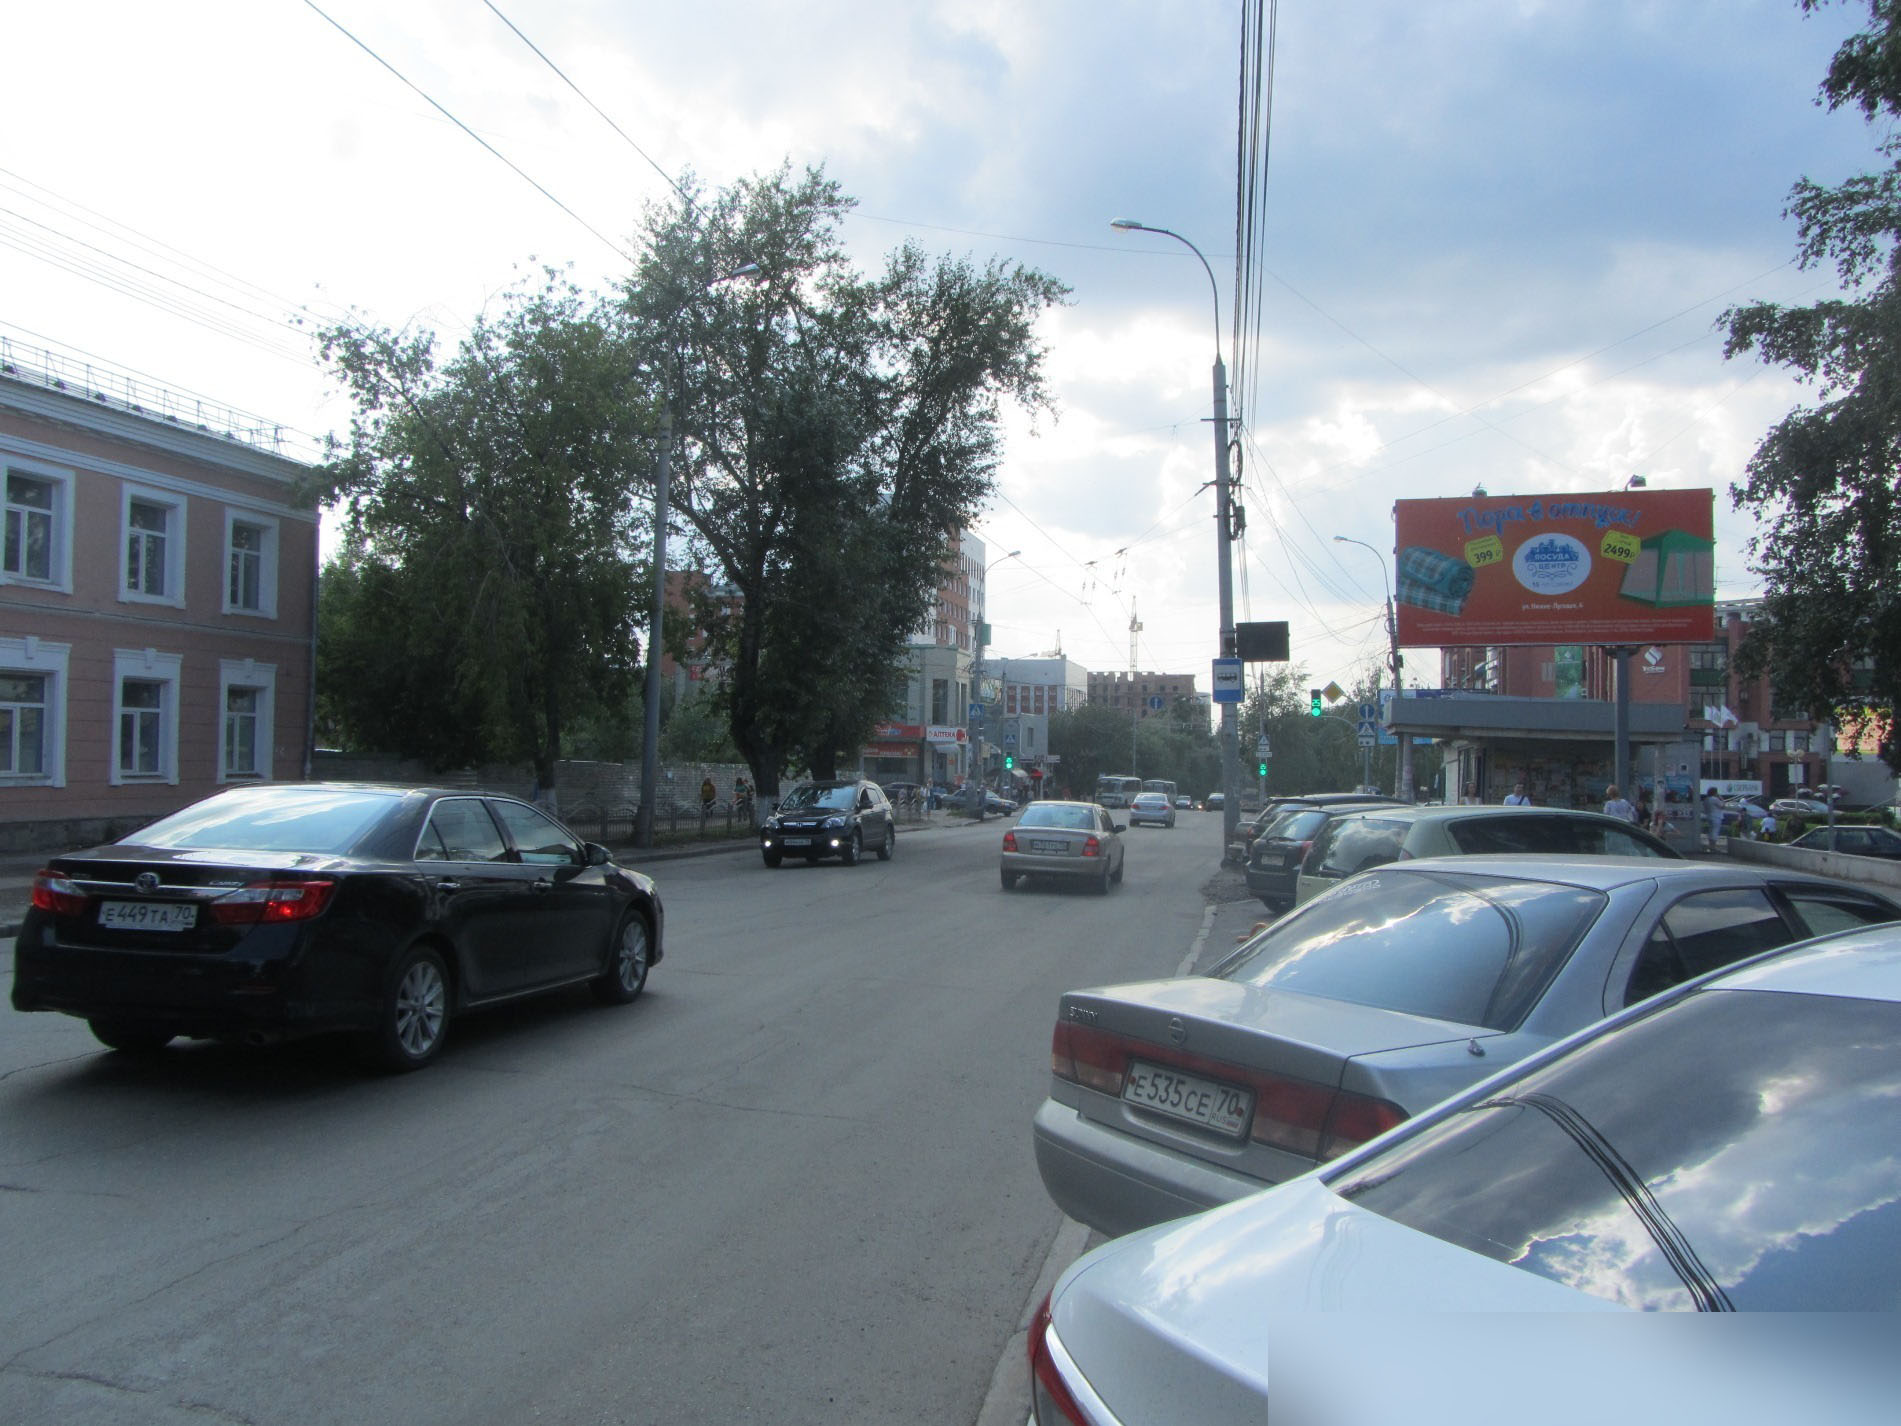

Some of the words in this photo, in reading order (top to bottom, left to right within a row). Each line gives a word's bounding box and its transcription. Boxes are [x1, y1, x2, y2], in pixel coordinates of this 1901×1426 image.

[1457, 505, 1526, 535] Пора
[1527, 499, 1544, 521] в
[1548, 502, 1642, 529] отпуск!
[1473, 550, 1493, 564] 399
[1603, 543, 1630, 558] 2499
